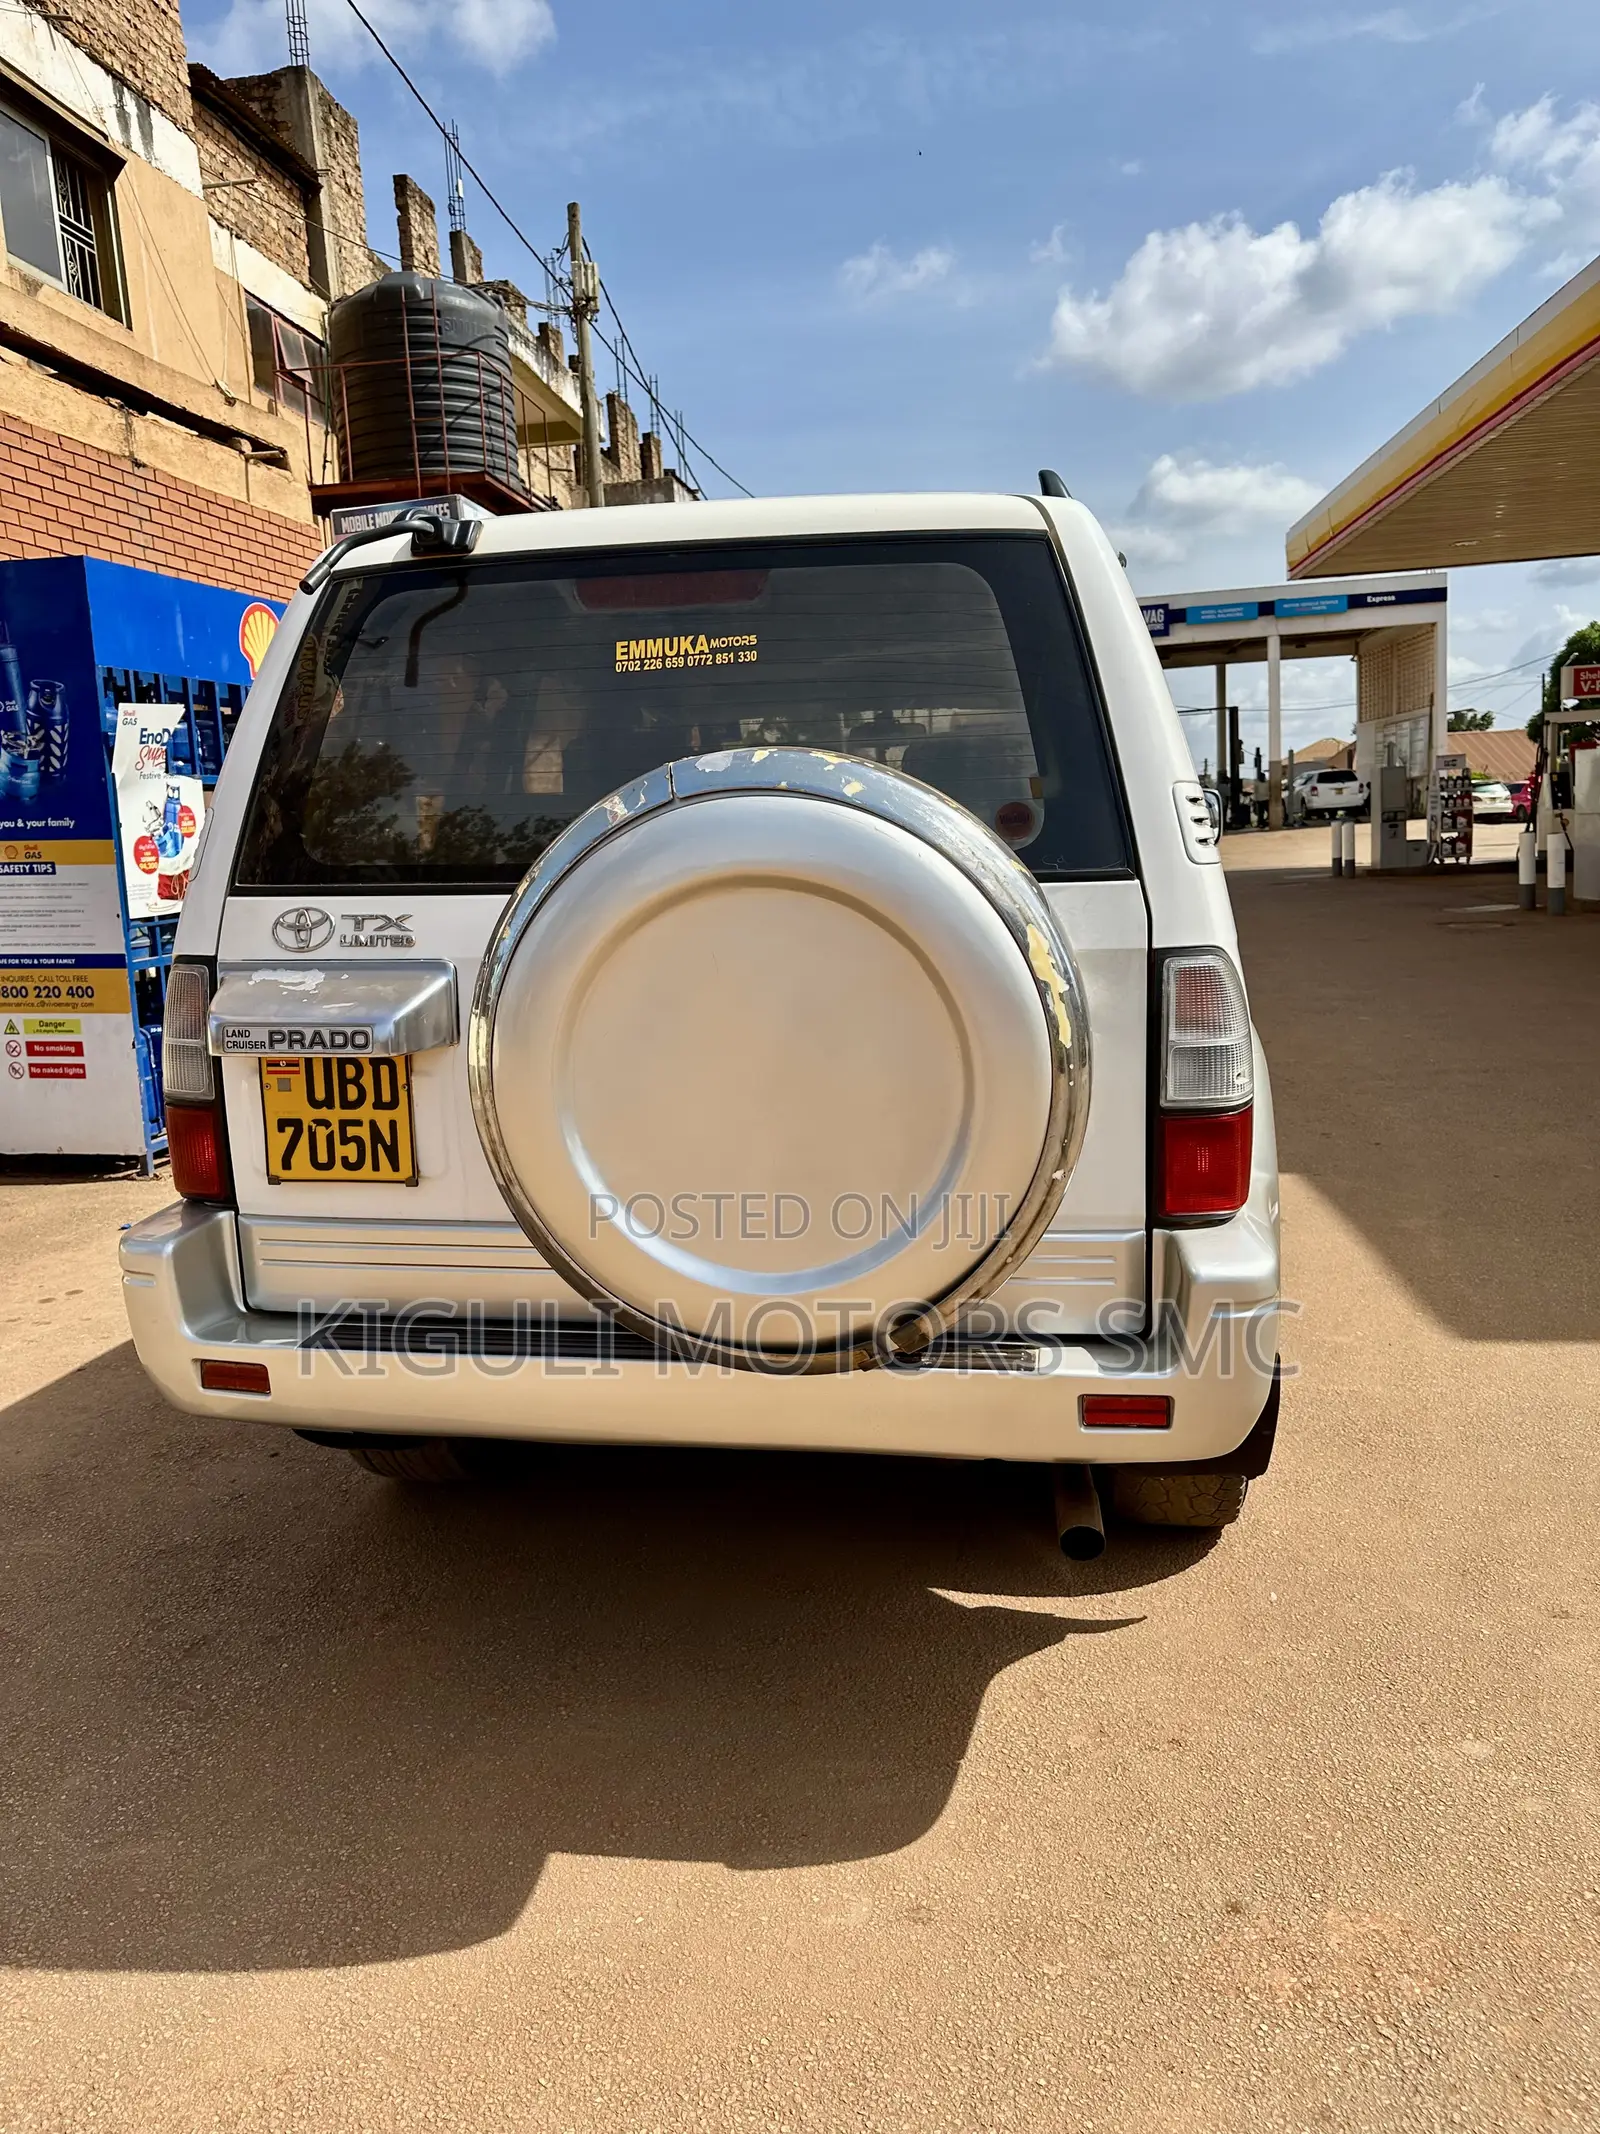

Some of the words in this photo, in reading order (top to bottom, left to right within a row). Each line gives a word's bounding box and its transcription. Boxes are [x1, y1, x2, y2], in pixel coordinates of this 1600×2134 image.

[340, 513, 375, 534] MOBILE
[375, 508, 405, 528] MON
[1366, 594, 1396, 604] Express
[1143, 608, 1165, 624] VAG
[615, 634, 710, 661] EMMUKA
[709, 635, 757, 649] MOTORS
[615, 659, 641, 673] 0702
[643, 657, 663, 671] 226
[665, 656, 685, 669] 659
[687, 653, 713, 667] 0772
[715, 651, 735, 664] 851
[737, 650, 758, 663] 330
[122, 717, 138, 726] GAS
[140, 772, 161, 780] Festive
[0, 820, 15, 830] you
[17, 818, 25, 828] &
[26, 820, 46, 830] your
[48, 816, 75, 829] family
[24, 851, 43, 860] GAS
[0, 864, 31, 874] SAFETY
[32, 863, 53, 873] TIPS
[340, 913, 415, 933] TX
[339, 934, 417, 948] LIMITED
[37, 975, 53, 983] CALL
[55, 975, 72, 983] TOLL
[73, 975, 89, 983] FREE
[33, 985, 62, 999] 220
[66, 985, 95, 999] 400
[38, 1020, 66, 1029] Danger
[226, 1029, 251, 1039] LAND
[267, 1029, 372, 1051] PRADO
[45, 1045, 76, 1054] smoking
[226, 1039, 267, 1050] CRUISER
[64, 1067, 84, 1076] lights
[303, 1057, 400, 1111] UBD
[276, 1117, 400, 1173] 705N
